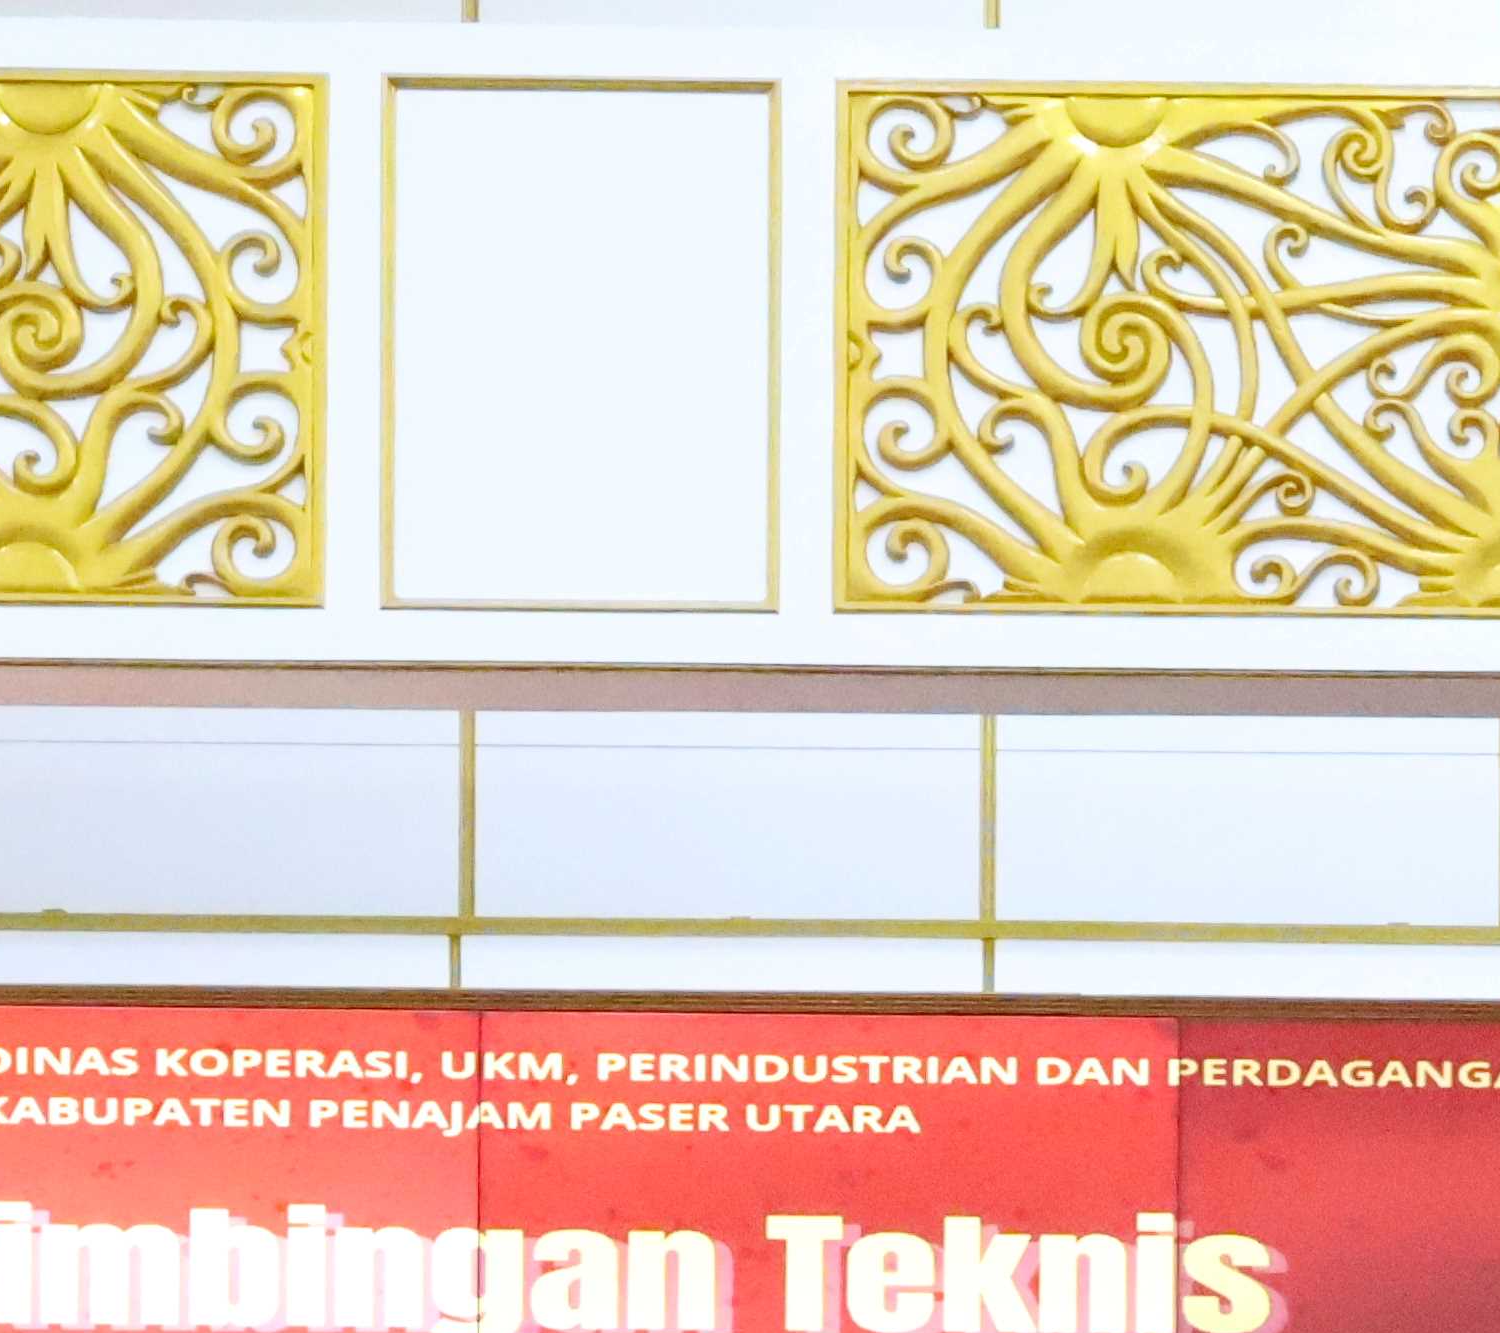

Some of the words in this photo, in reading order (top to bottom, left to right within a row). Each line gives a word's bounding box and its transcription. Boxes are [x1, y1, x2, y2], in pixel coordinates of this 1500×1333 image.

[155, 1048, 423, 1084] KOPERASI,
[441, 1051, 579, 1086] UKM,
[596, 1053, 1018, 1085] PERINDUSTRIAN
[1036, 1056, 1150, 1087] DAN
[308, 1100, 552, 1138] PENAJAM
[570, 1102, 730, 1132] PASER
[745, 1104, 921, 1134] UTARA
